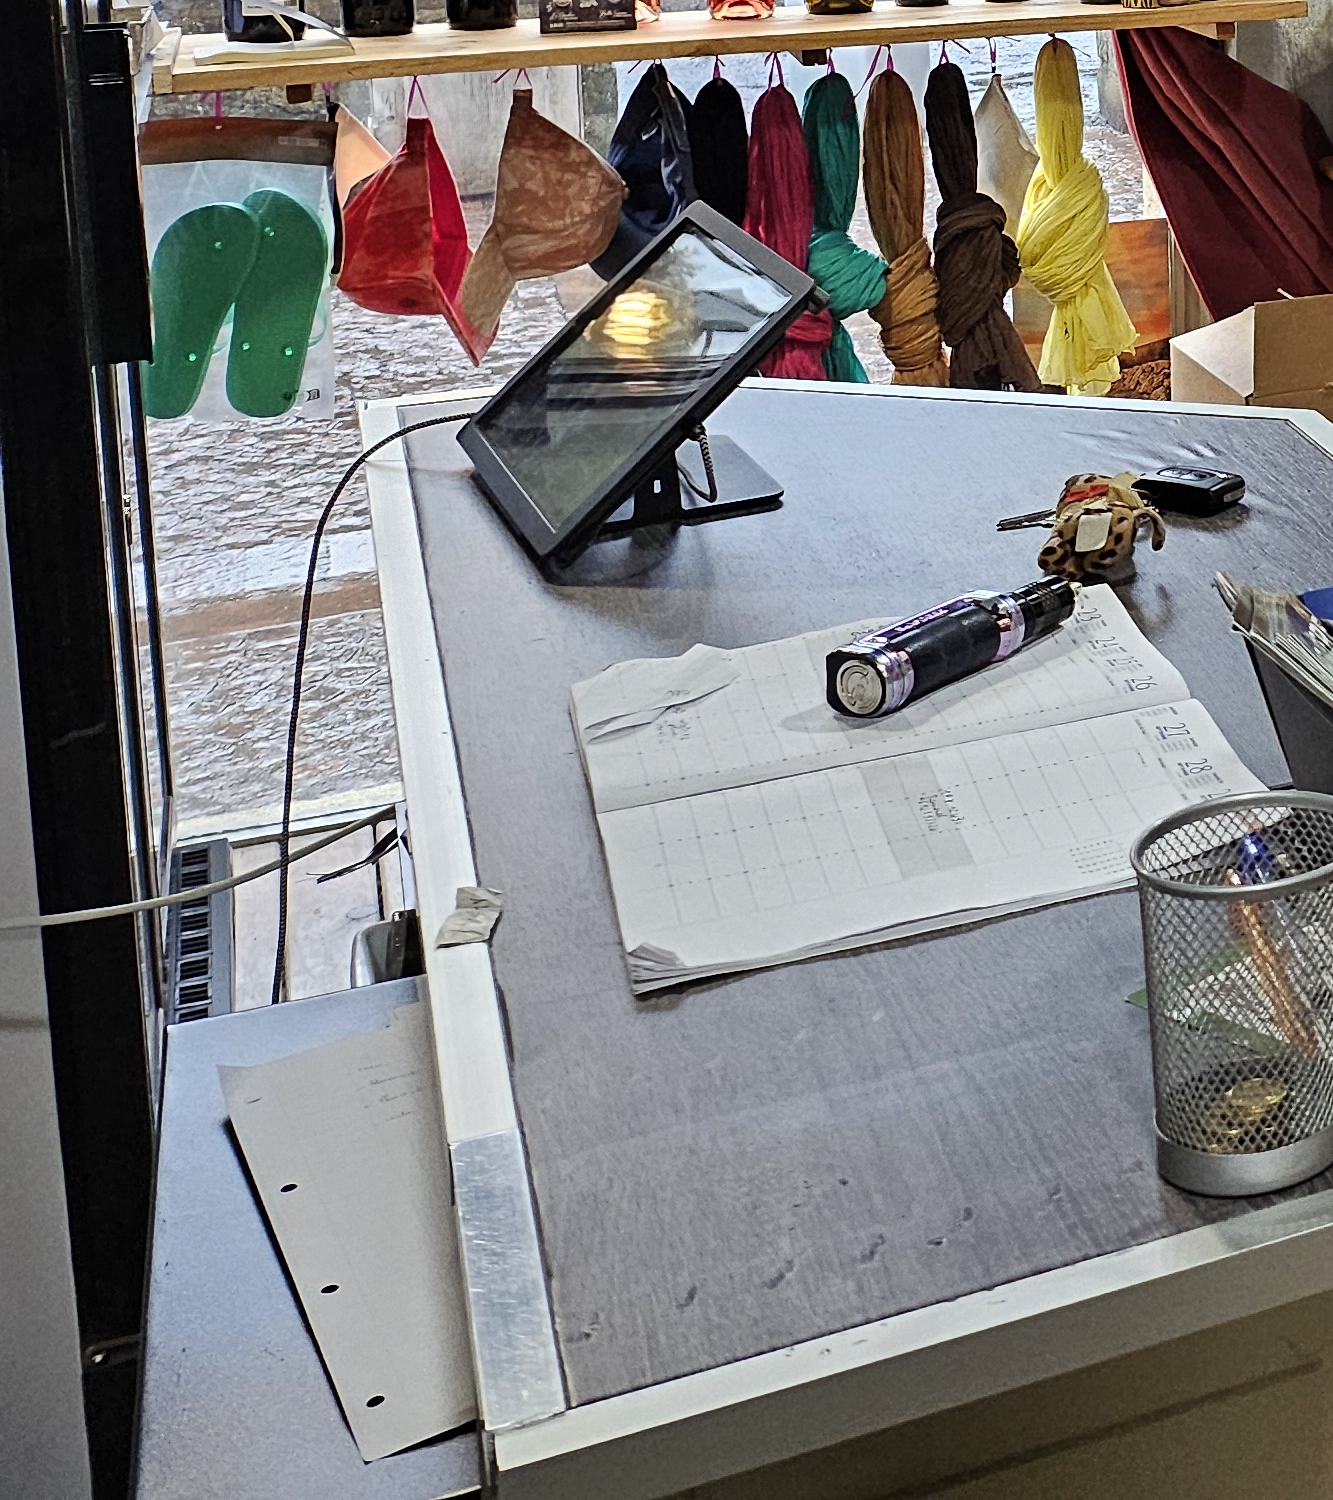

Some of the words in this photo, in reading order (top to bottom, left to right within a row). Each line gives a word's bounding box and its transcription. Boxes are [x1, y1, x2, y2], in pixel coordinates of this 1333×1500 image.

[1130, 674, 1157, 691] 26
[1162, 722, 1191, 739] 27
[1184, 758, 1213, 775] 28
